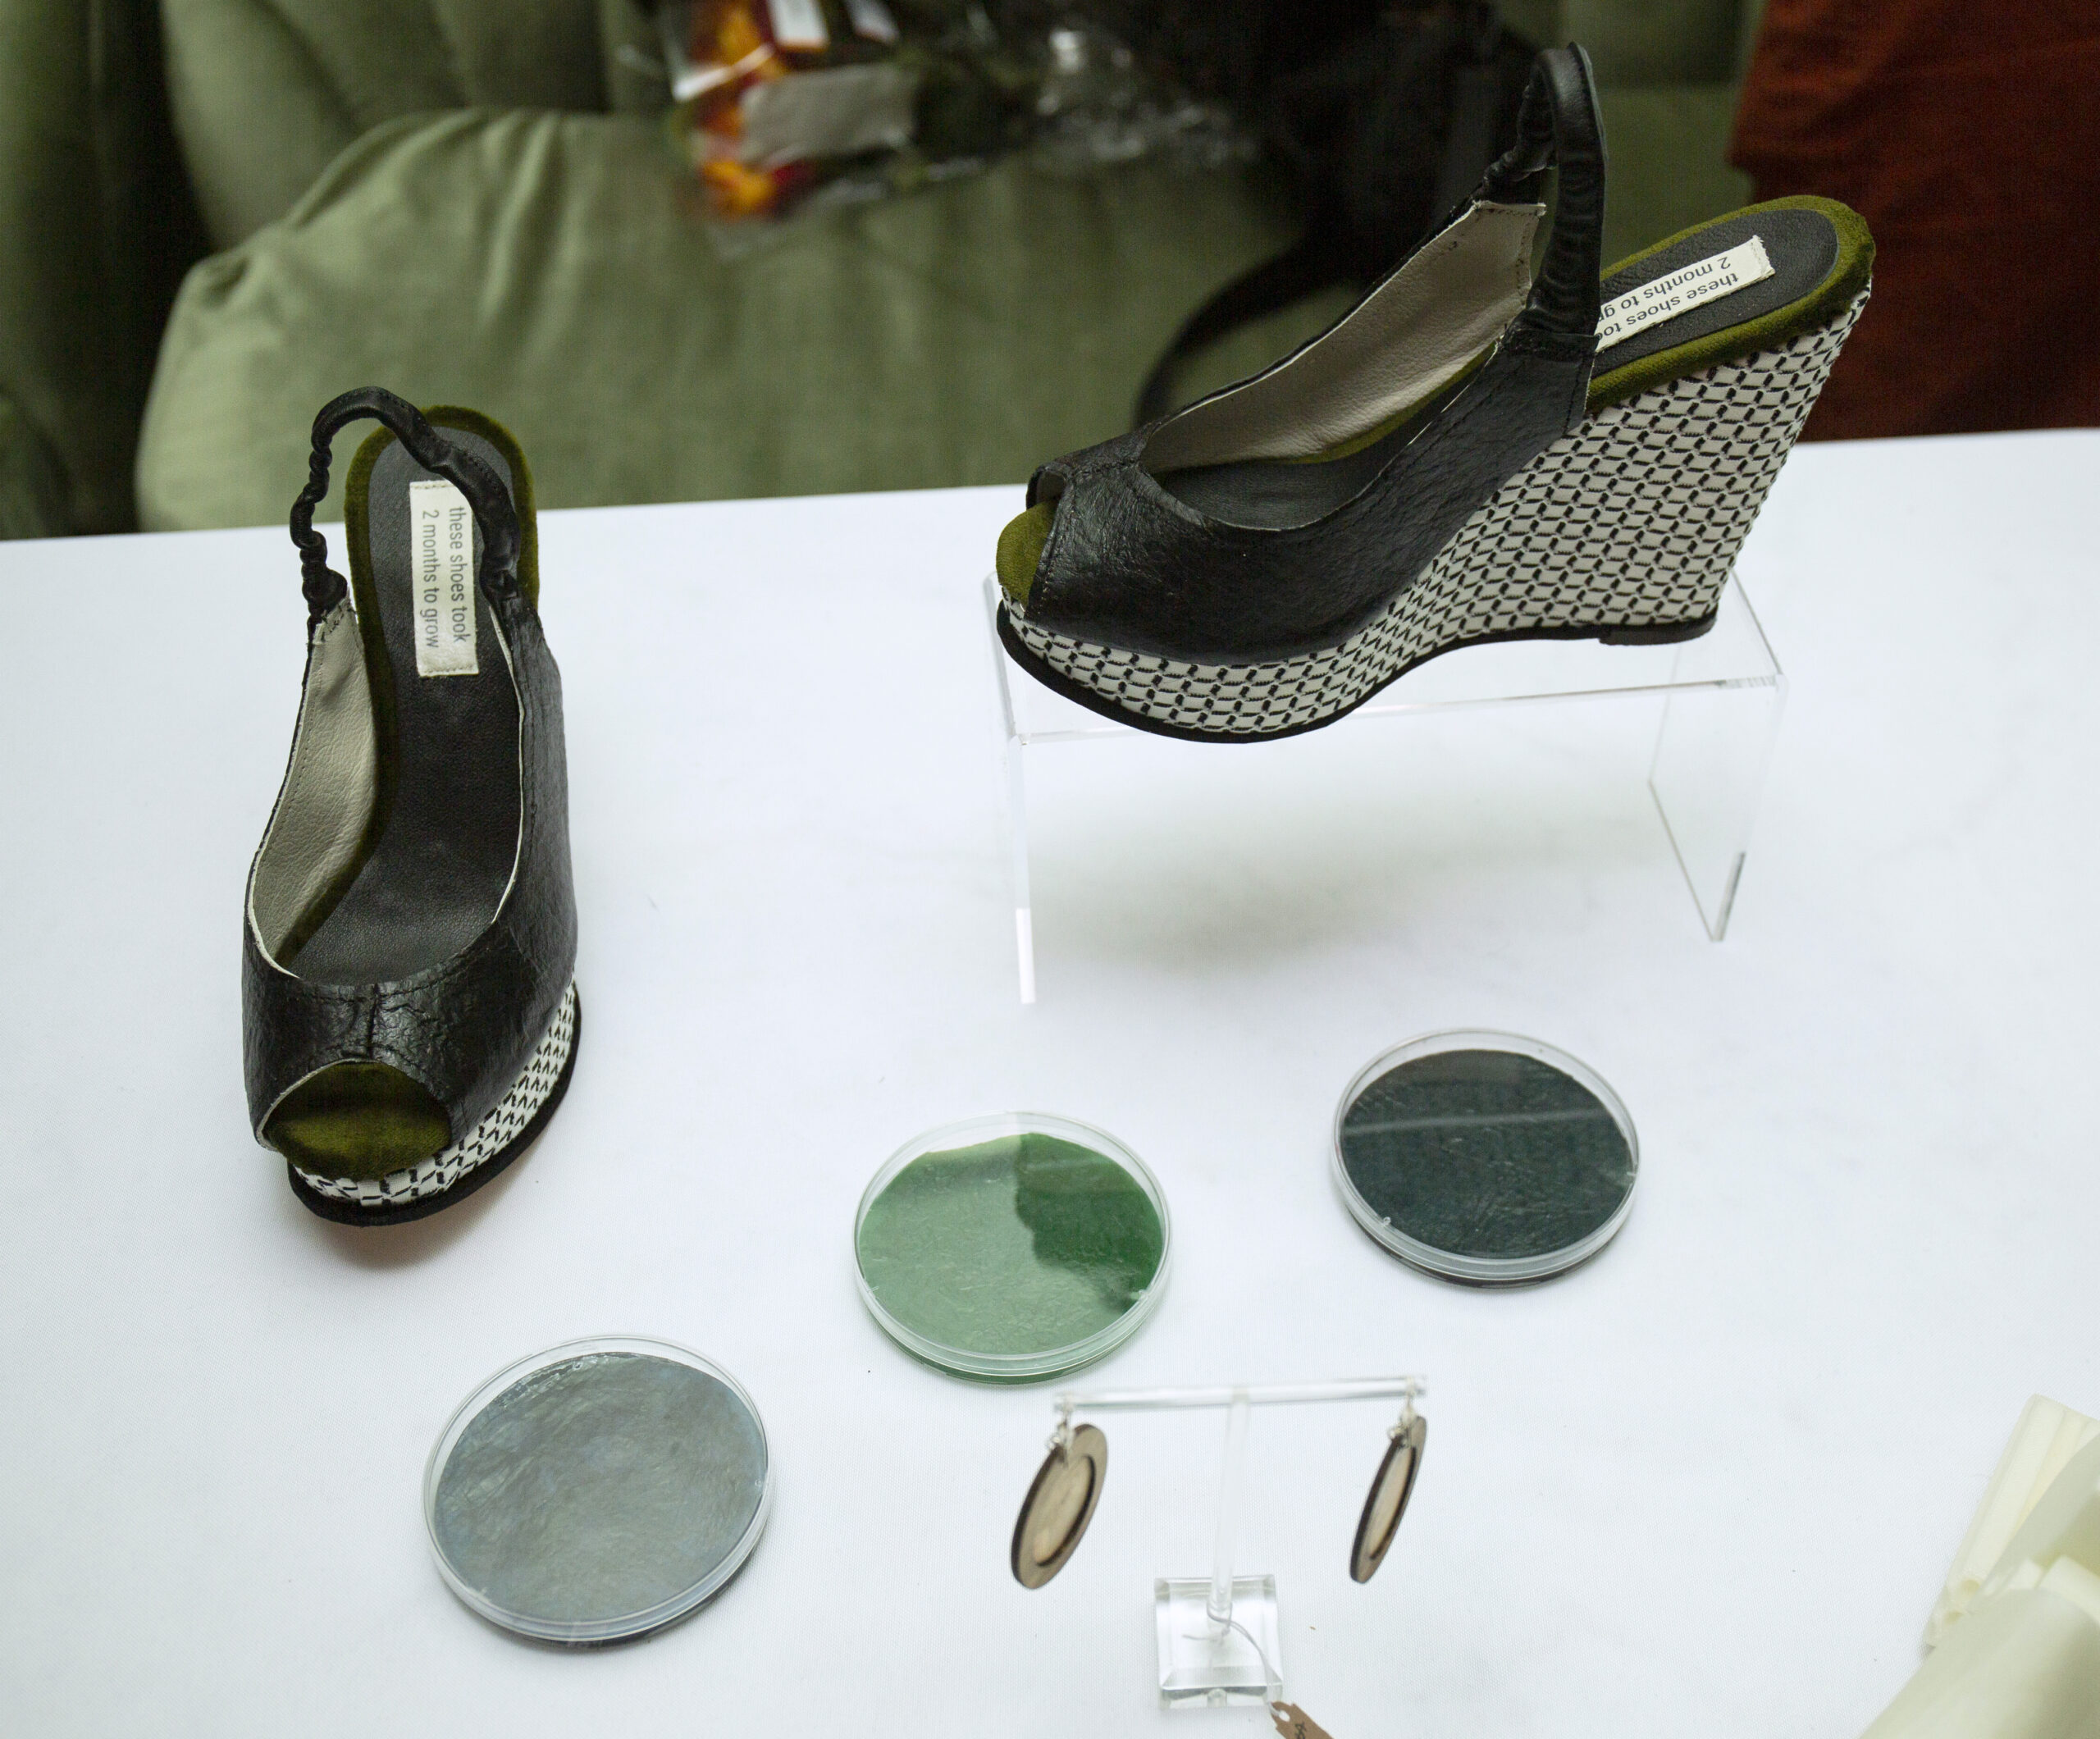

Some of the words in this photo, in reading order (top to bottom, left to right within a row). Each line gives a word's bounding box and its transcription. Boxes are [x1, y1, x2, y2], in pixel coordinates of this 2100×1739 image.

[1717, 256, 1732, 269] 2
[1643, 263, 1713, 299] months
[1687, 272, 1740, 299] these
[1621, 295, 1639, 309] to
[1626, 296, 1681, 326] shoes
[422, 509, 440, 519] 2
[449, 506, 466, 550] these
[422, 524, 441, 582] months
[450, 555, 468, 601] shoes
[423, 587, 440, 603] to
[419, 608, 439, 648] grow
[452, 605, 471, 643] took
